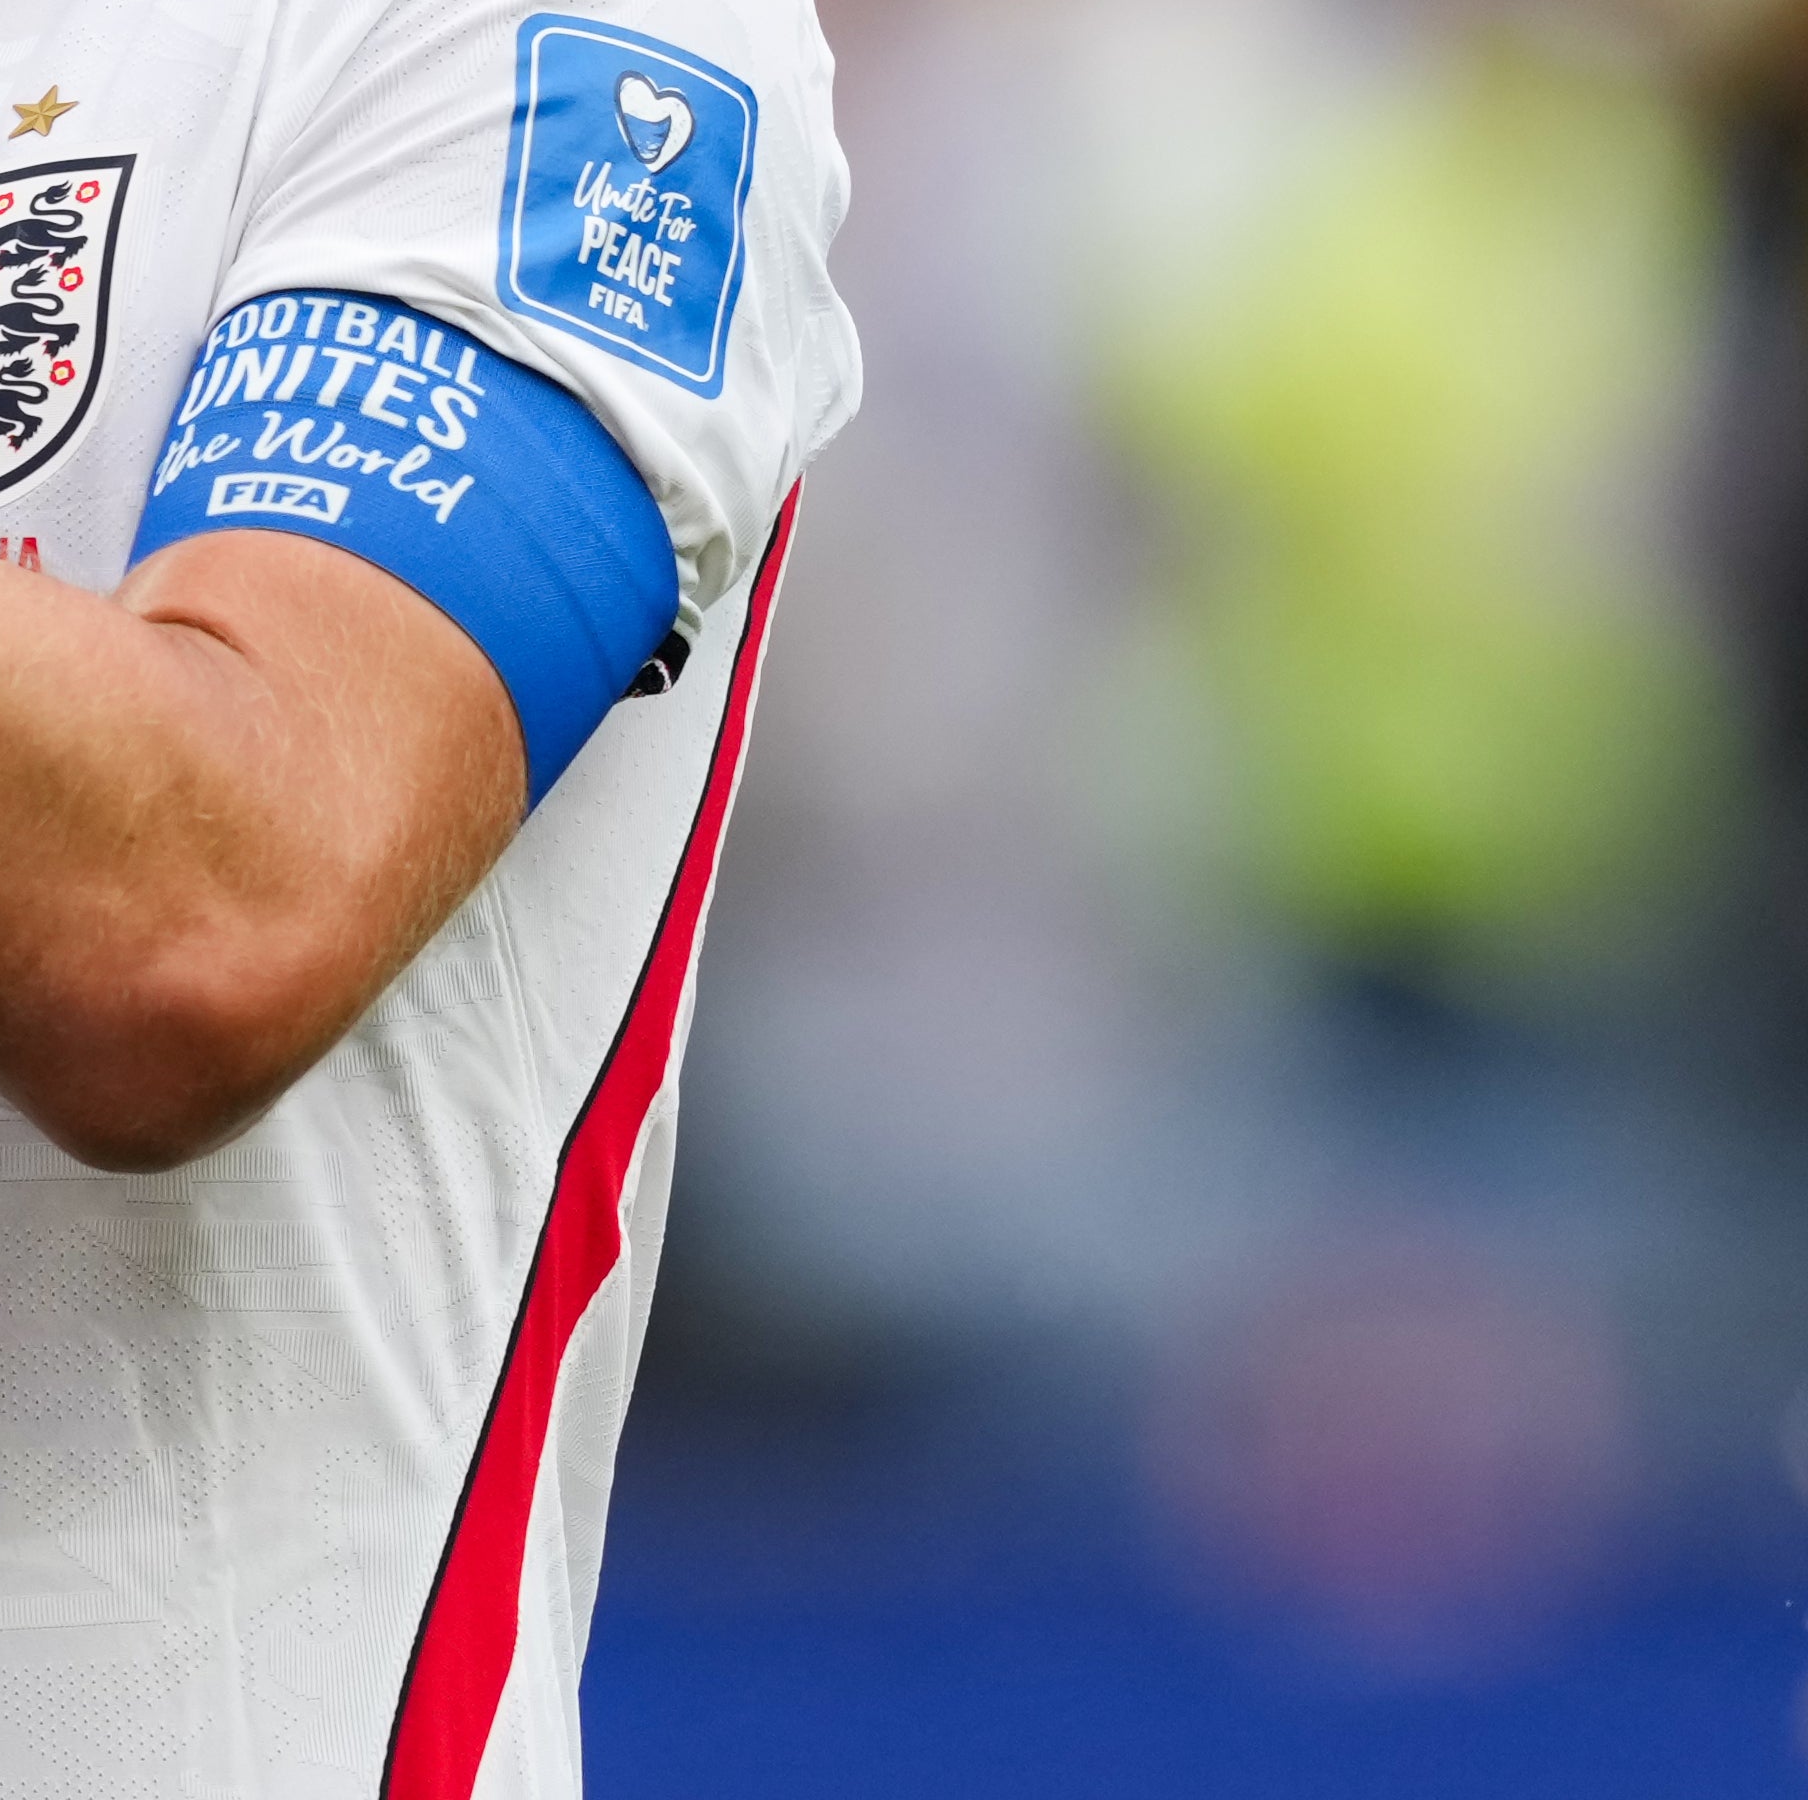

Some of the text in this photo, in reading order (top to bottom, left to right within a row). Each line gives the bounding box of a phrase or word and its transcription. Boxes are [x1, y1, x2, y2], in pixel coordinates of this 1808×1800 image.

[573, 160, 697, 242] Unite For
[577, 215, 682, 307] PEACE
[588, 281, 645, 332] FIFA
[202, 296, 485, 396] FOOTBALL
[177, 344, 478, 451] UNITES
[152, 410, 475, 525] the World
[220, 479, 331, 515] FIFA
